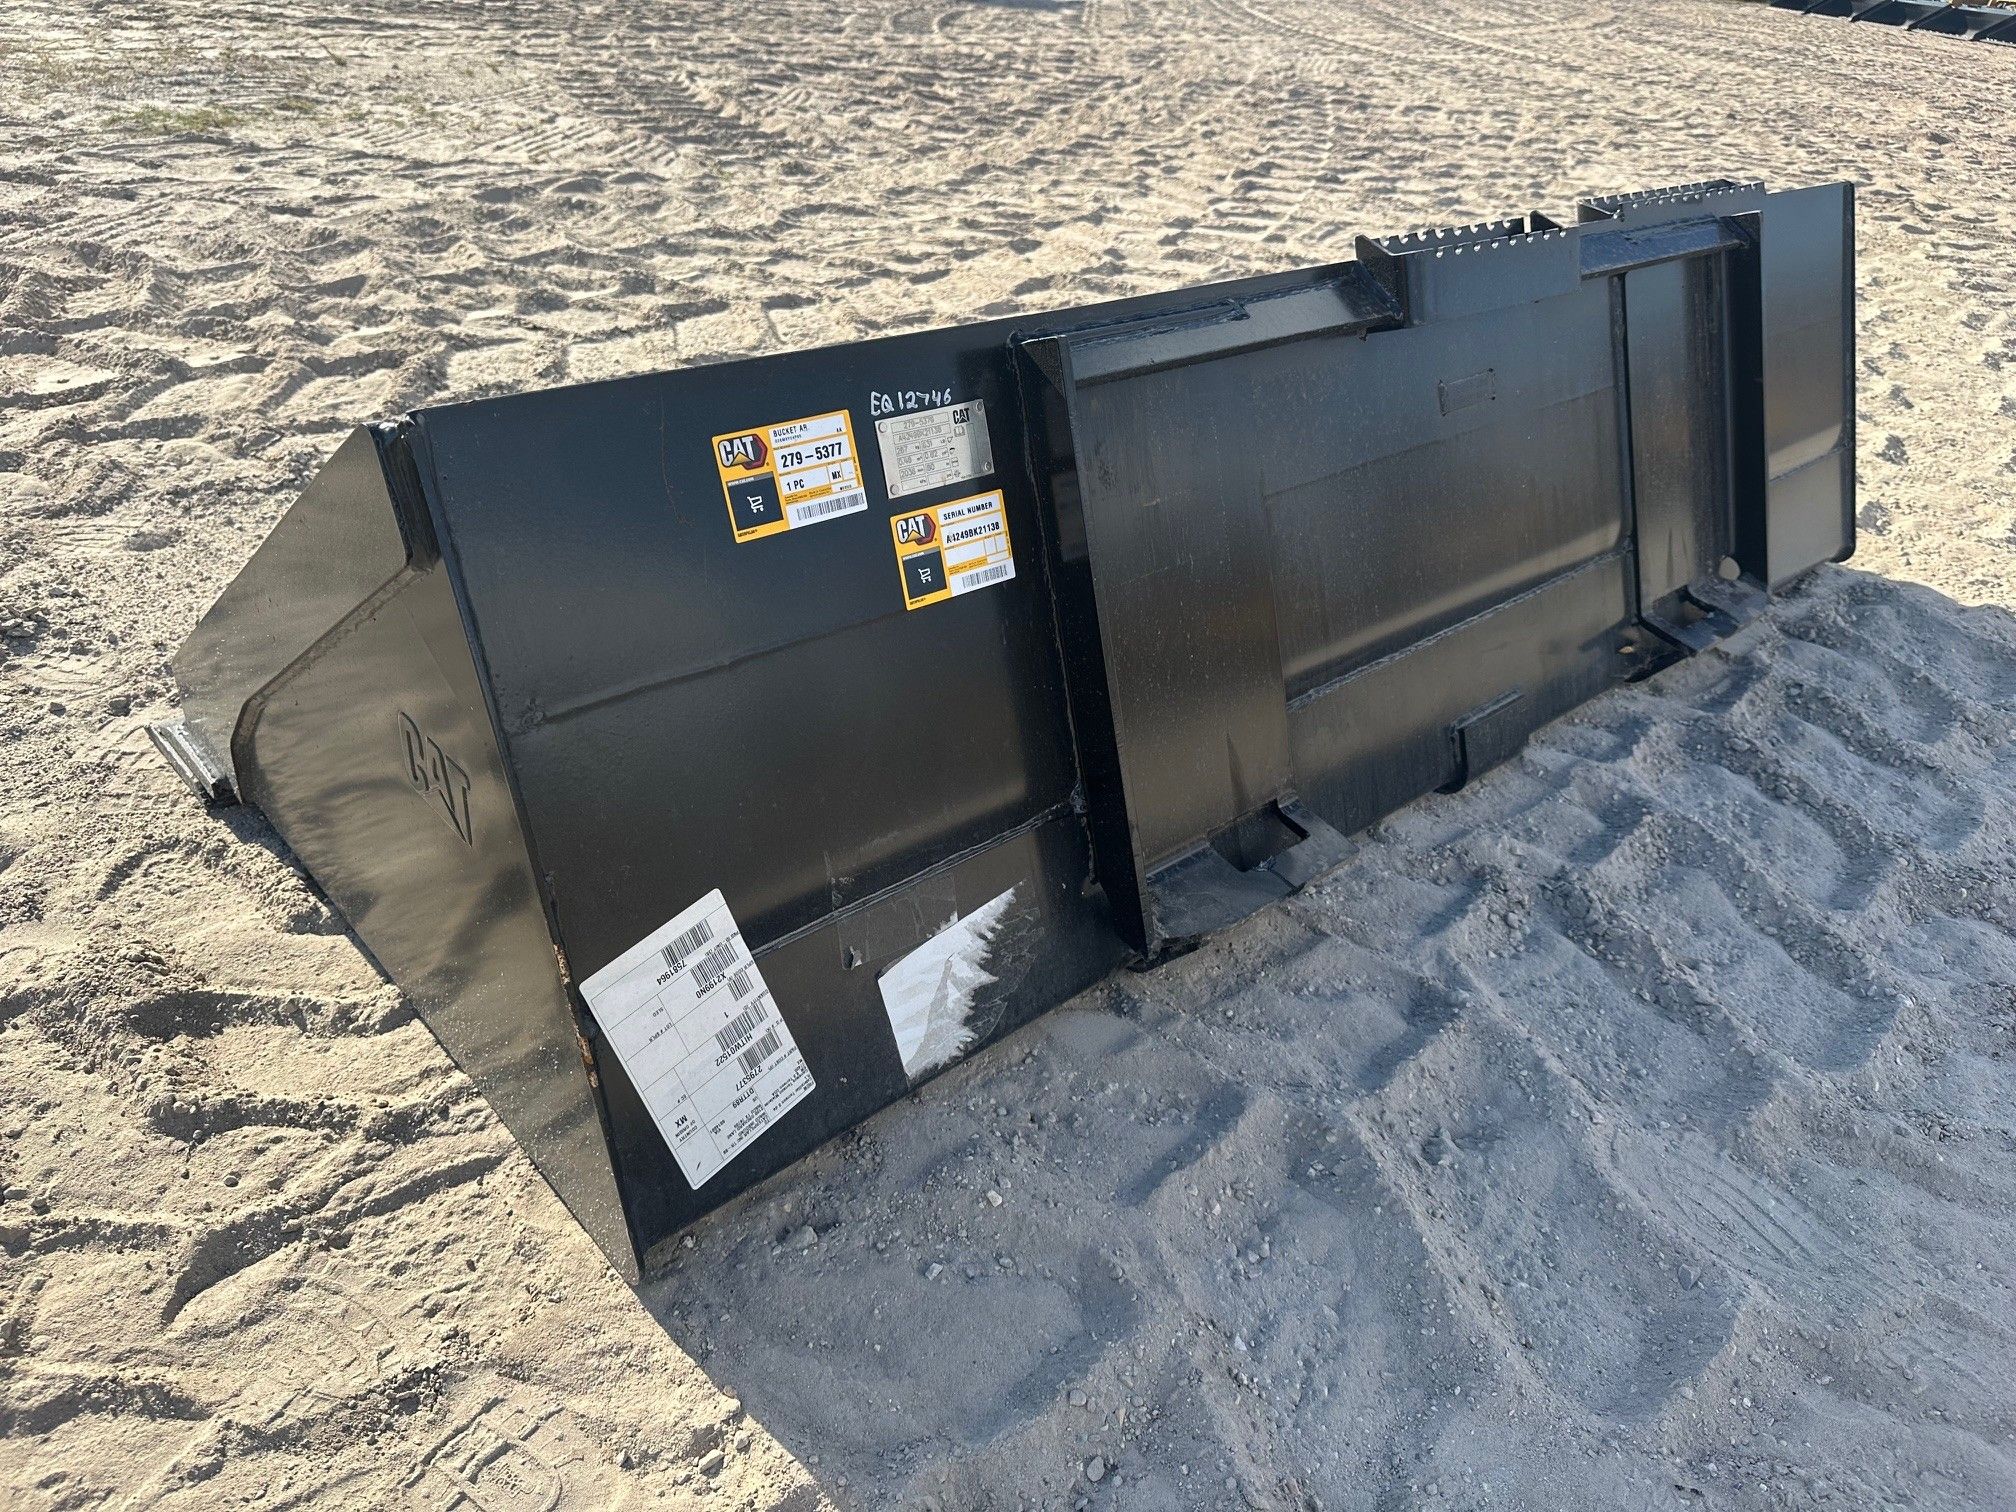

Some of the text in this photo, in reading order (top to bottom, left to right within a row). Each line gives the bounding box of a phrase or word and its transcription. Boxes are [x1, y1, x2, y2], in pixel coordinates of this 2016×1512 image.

[952, 407, 970, 424] CAT
[772, 426, 796, 437] BUCKET
[717, 435, 757, 467] CAT
[831, 469, 841, 479] MX
[786, 478, 804, 491] 1 PC
[943, 501, 992, 520] SERIAL NUMBER
[896, 514, 927, 544] CAT
[655, 958, 687, 986] 7581964
[723, 1010, 729, 1018] 1
[734, 1064, 762, 1091] 2795377
[674, 1114, 687, 1128] MX
